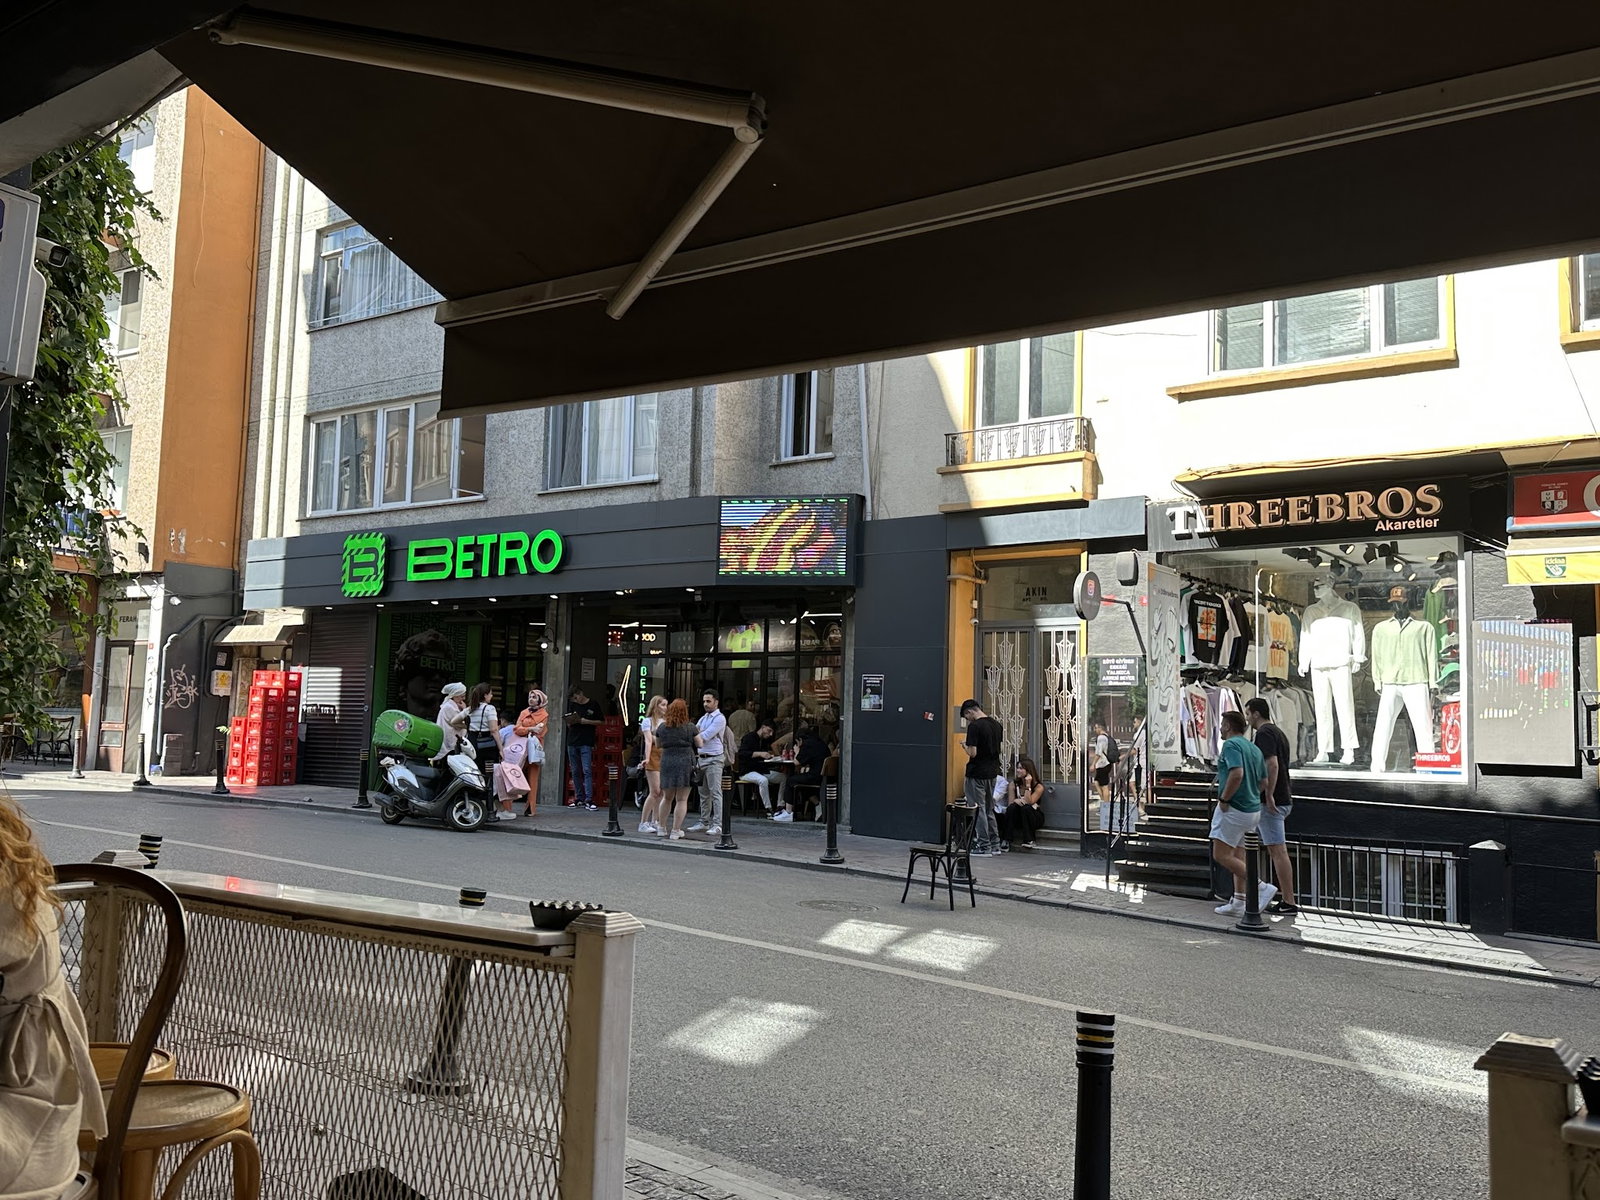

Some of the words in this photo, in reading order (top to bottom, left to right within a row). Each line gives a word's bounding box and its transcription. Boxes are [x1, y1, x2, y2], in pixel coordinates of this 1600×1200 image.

[1166, 484, 1442, 534] THREEBROS
[1375, 517, 1439, 531] Akaretler
[407, 529, 563, 582] BETRO
[1025, 586, 1047, 597] AKIN
[420, 655, 456, 672] BETRO
